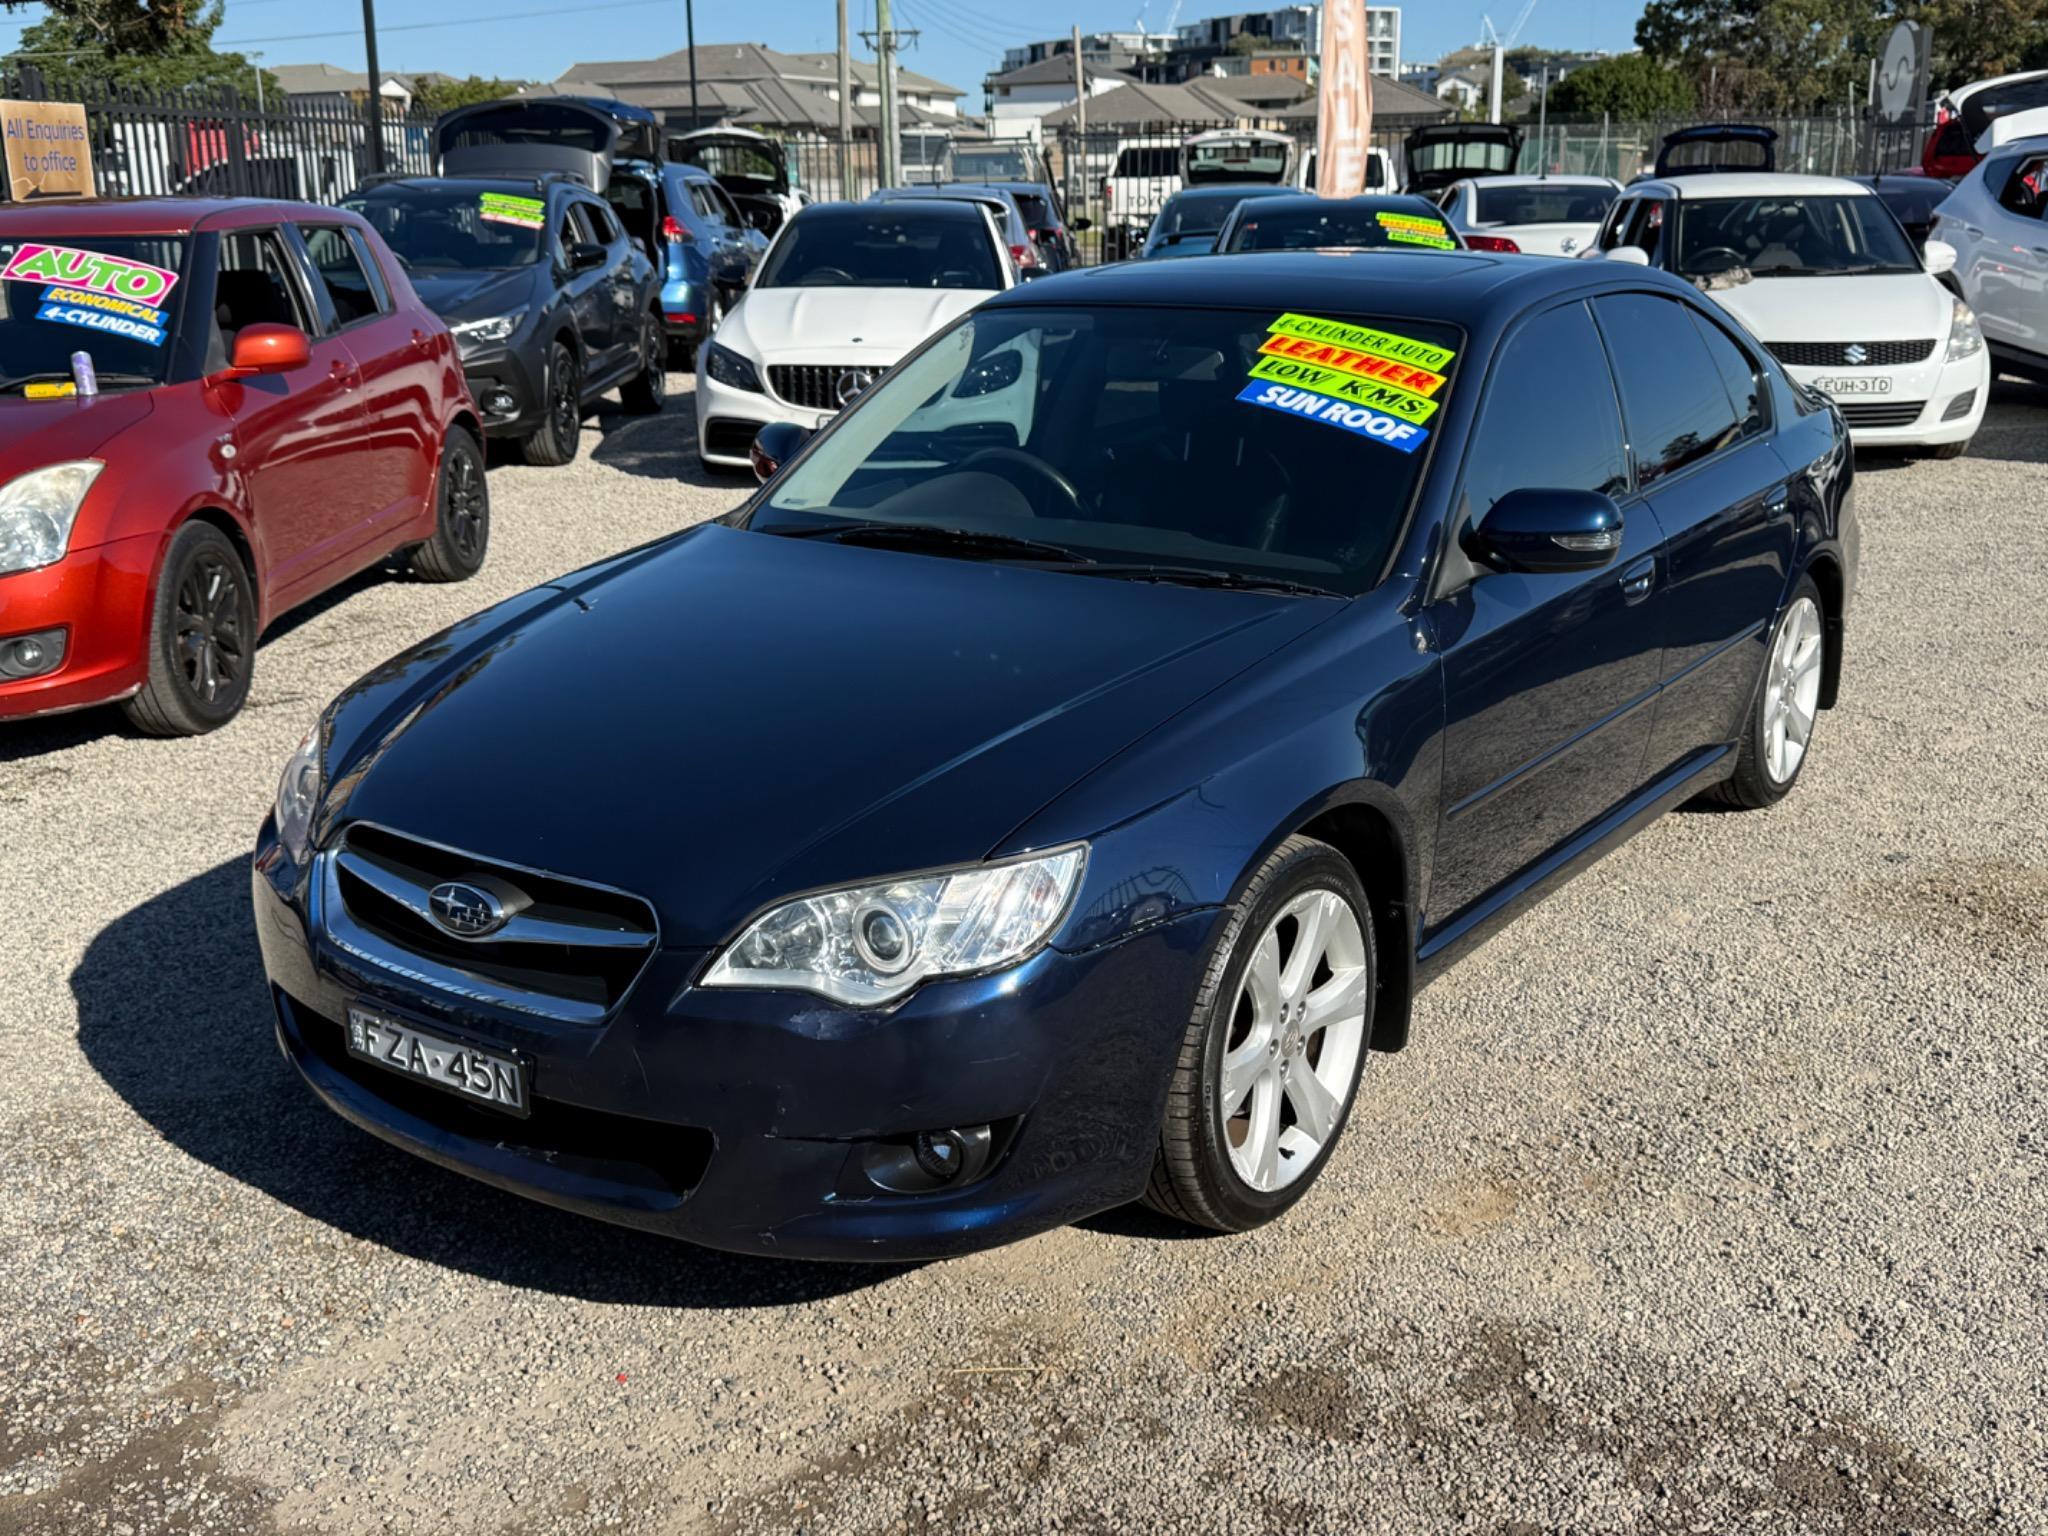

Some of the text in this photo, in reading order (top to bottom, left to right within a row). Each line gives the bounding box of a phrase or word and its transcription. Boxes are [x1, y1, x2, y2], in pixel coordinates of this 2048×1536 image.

[7, 118, 85, 144] All Enquiries
[24, 151, 77, 173] to office
[11, 248, 165, 298] AUTO
[44, 306, 161, 342] 4-CYLINDER
[48, 287, 160, 323] ECONOMICAL
[1264, 336, 1438, 392] LEATHER
[1278, 318, 1445, 364] 4-CYLINDER AUTO
[1259, 360, 1428, 417] LOW KMS
[1257, 385, 1418, 442] SUN ROOF
